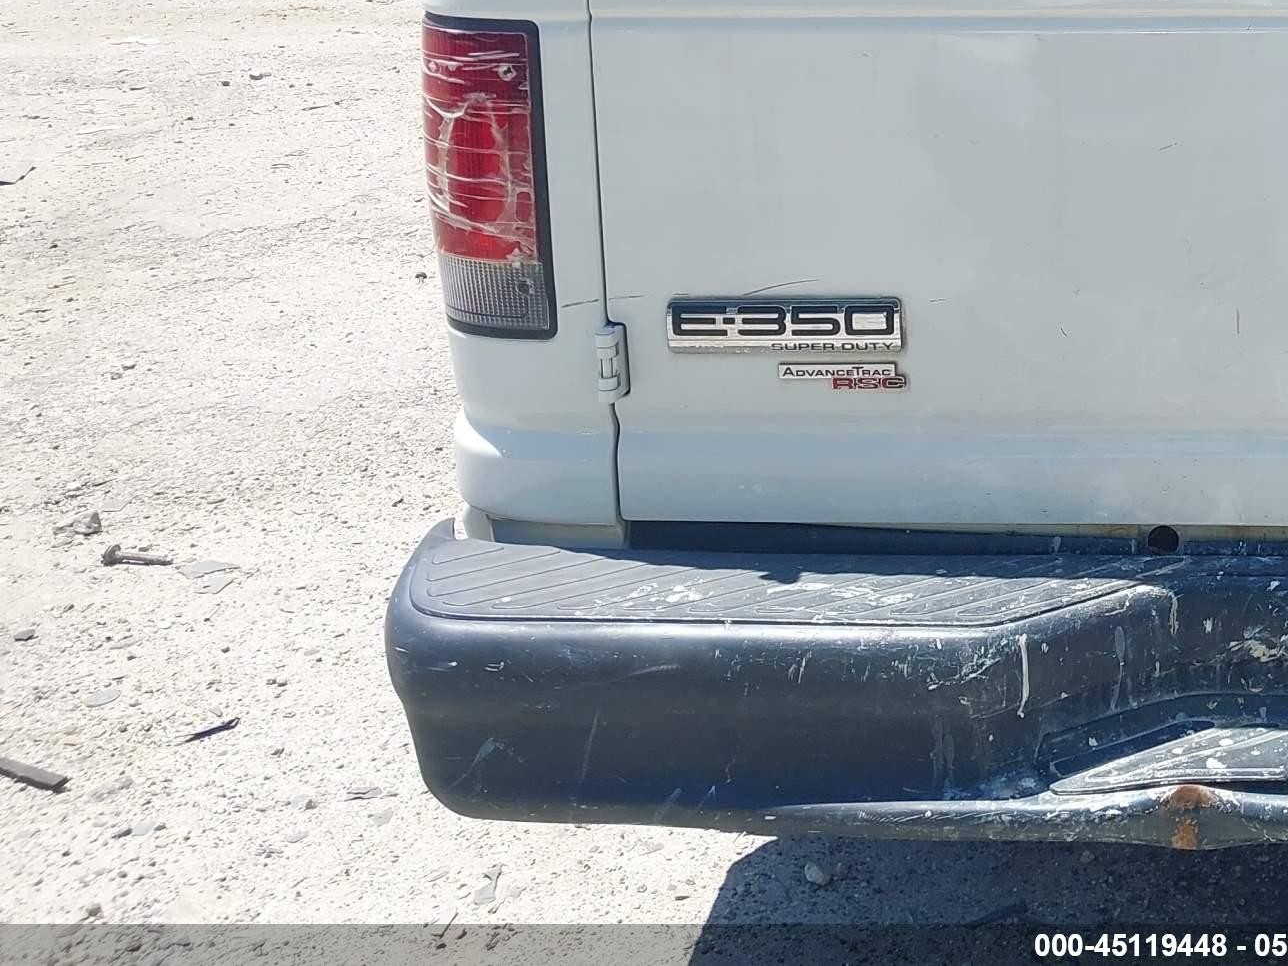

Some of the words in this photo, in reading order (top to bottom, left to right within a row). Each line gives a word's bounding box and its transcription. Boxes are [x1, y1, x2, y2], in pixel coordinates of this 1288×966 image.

[671, 304, 896, 337] E-350
[770, 342, 838, 352] SUPER
[841, 342, 895, 352] DUTY
[831, 377, 907, 390] RSC
